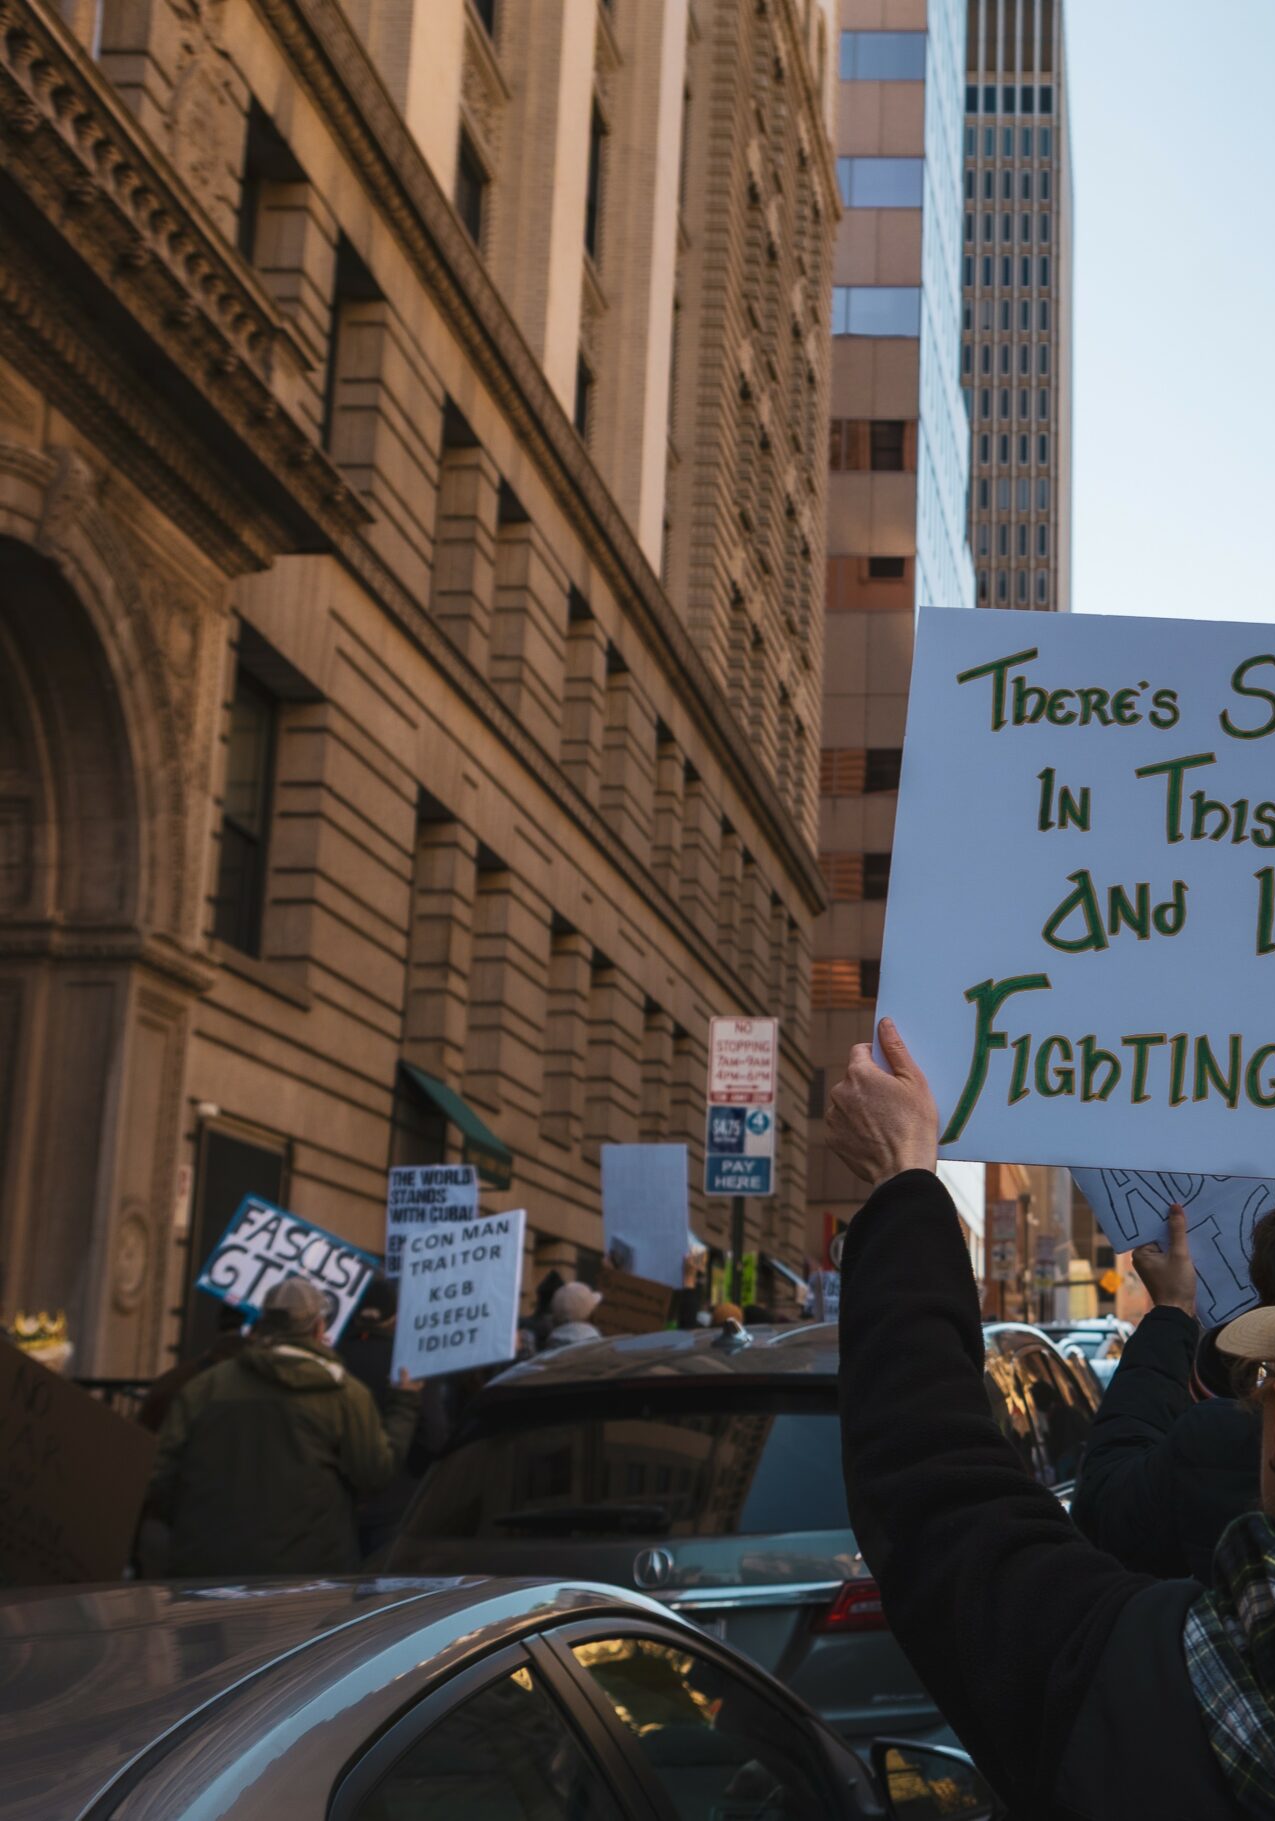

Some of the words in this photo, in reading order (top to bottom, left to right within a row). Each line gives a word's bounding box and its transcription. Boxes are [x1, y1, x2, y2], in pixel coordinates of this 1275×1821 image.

[735, 1022, 752, 1034] NO
[716, 1040, 770, 1053] STOPPING
[720, 1160, 756, 1173] PAY
[392, 1170, 416, 1187] THE
[420, 1168, 472, 1186] WORLD
[714, 1175, 762, 1190] HERE
[391, 1188, 447, 1205] STANDS
[390, 1207, 426, 1223] WITH
[411, 1232, 454, 1254] CON
[461, 1220, 511, 1242] MAN
[232, 1204, 374, 1297] FASCIST
[409, 1245, 503, 1277] TRAITOR
[413, 1303, 491, 1331] USEFUL
[417, 1328, 479, 1353] IDIOT
